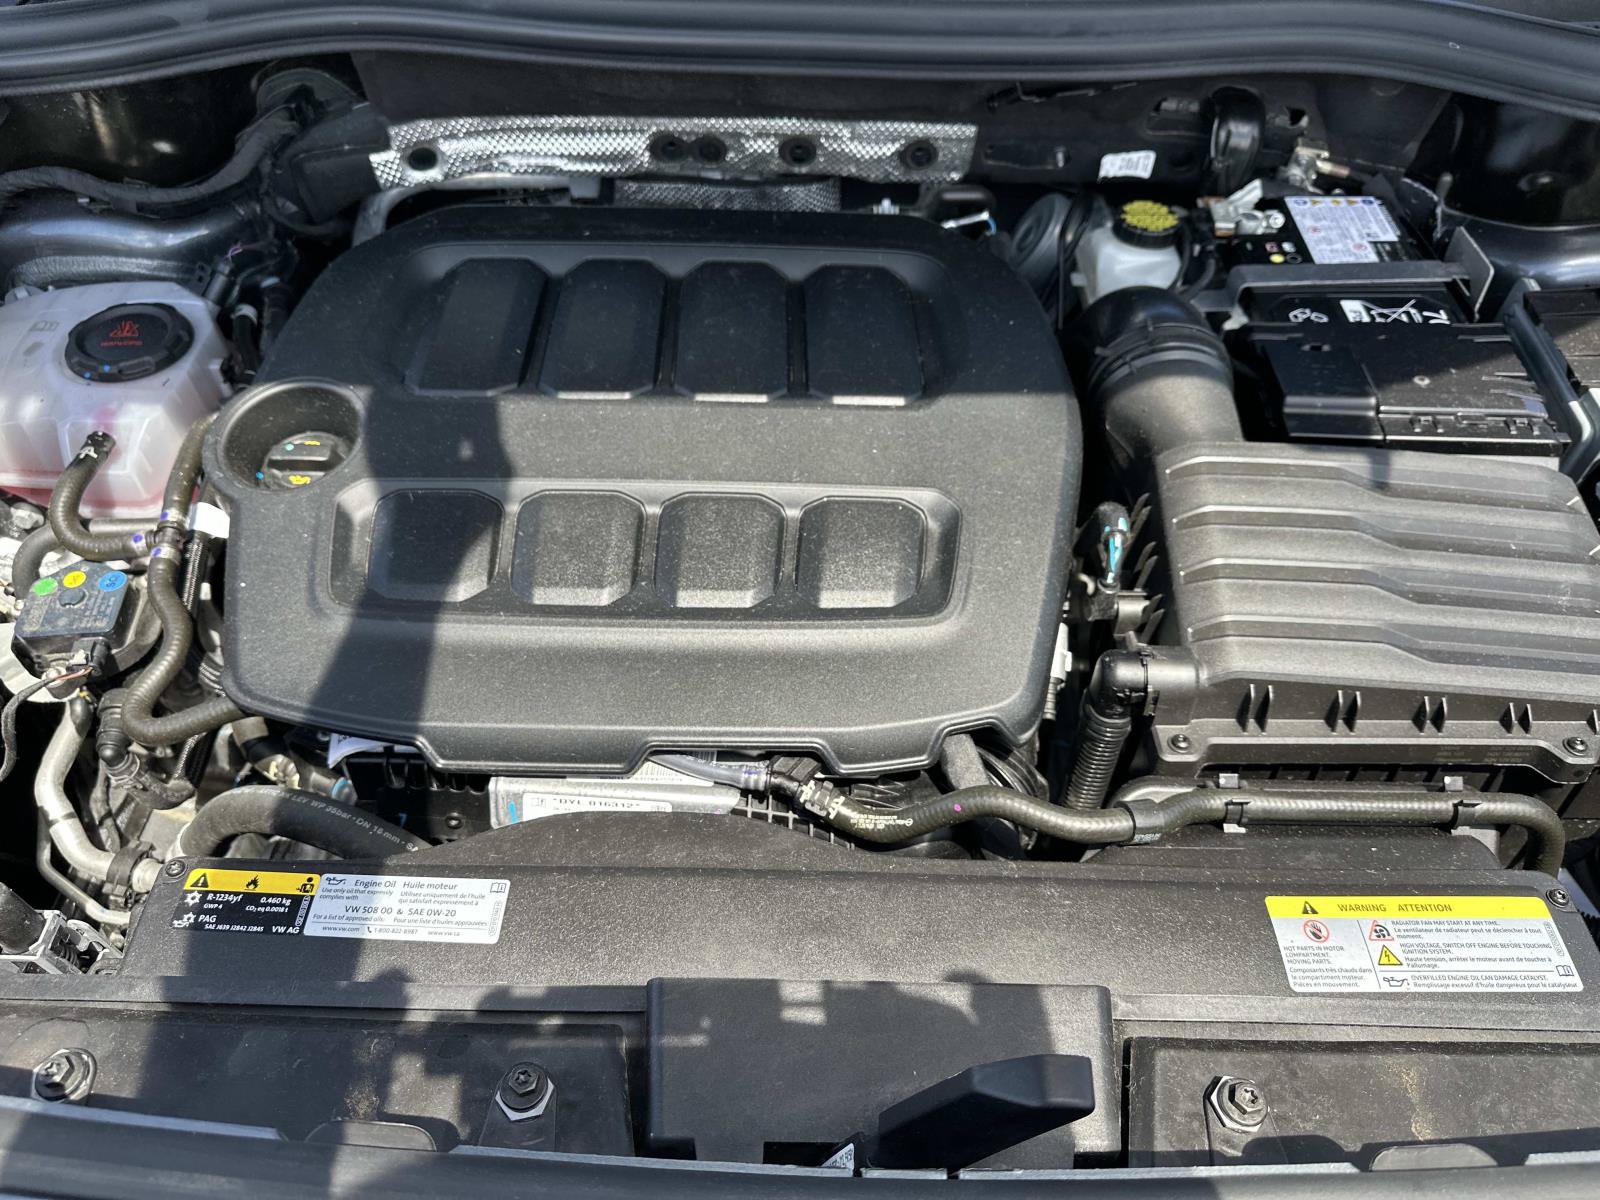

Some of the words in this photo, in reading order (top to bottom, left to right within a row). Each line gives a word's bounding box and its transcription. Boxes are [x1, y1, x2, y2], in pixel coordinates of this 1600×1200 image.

[310, 799, 327, 809] WP
[326, 805, 352, 820] 35bar
[355, 817, 371, 829] DN
[372, 824, 383, 835] 16
[383, 831, 401, 844] mm
[354, 880, 383, 888] Engine
[384, 880, 397, 888] Oil
[402, 881, 427, 889] Huile
[426, 882, 458, 890] moteur
[206, 894, 244, 905] R-1234yf
[260, 896, 282, 904] 0.460
[282, 897, 292, 906] kg
[345, 905, 361, 913] VW
[361, 906, 379, 914] 508
[408, 908, 425, 916] SAE
[1337, 904, 1387, 912] WARNING
[1398, 904, 1453, 912] ATTENTION
[286, 926, 300, 934] AG
